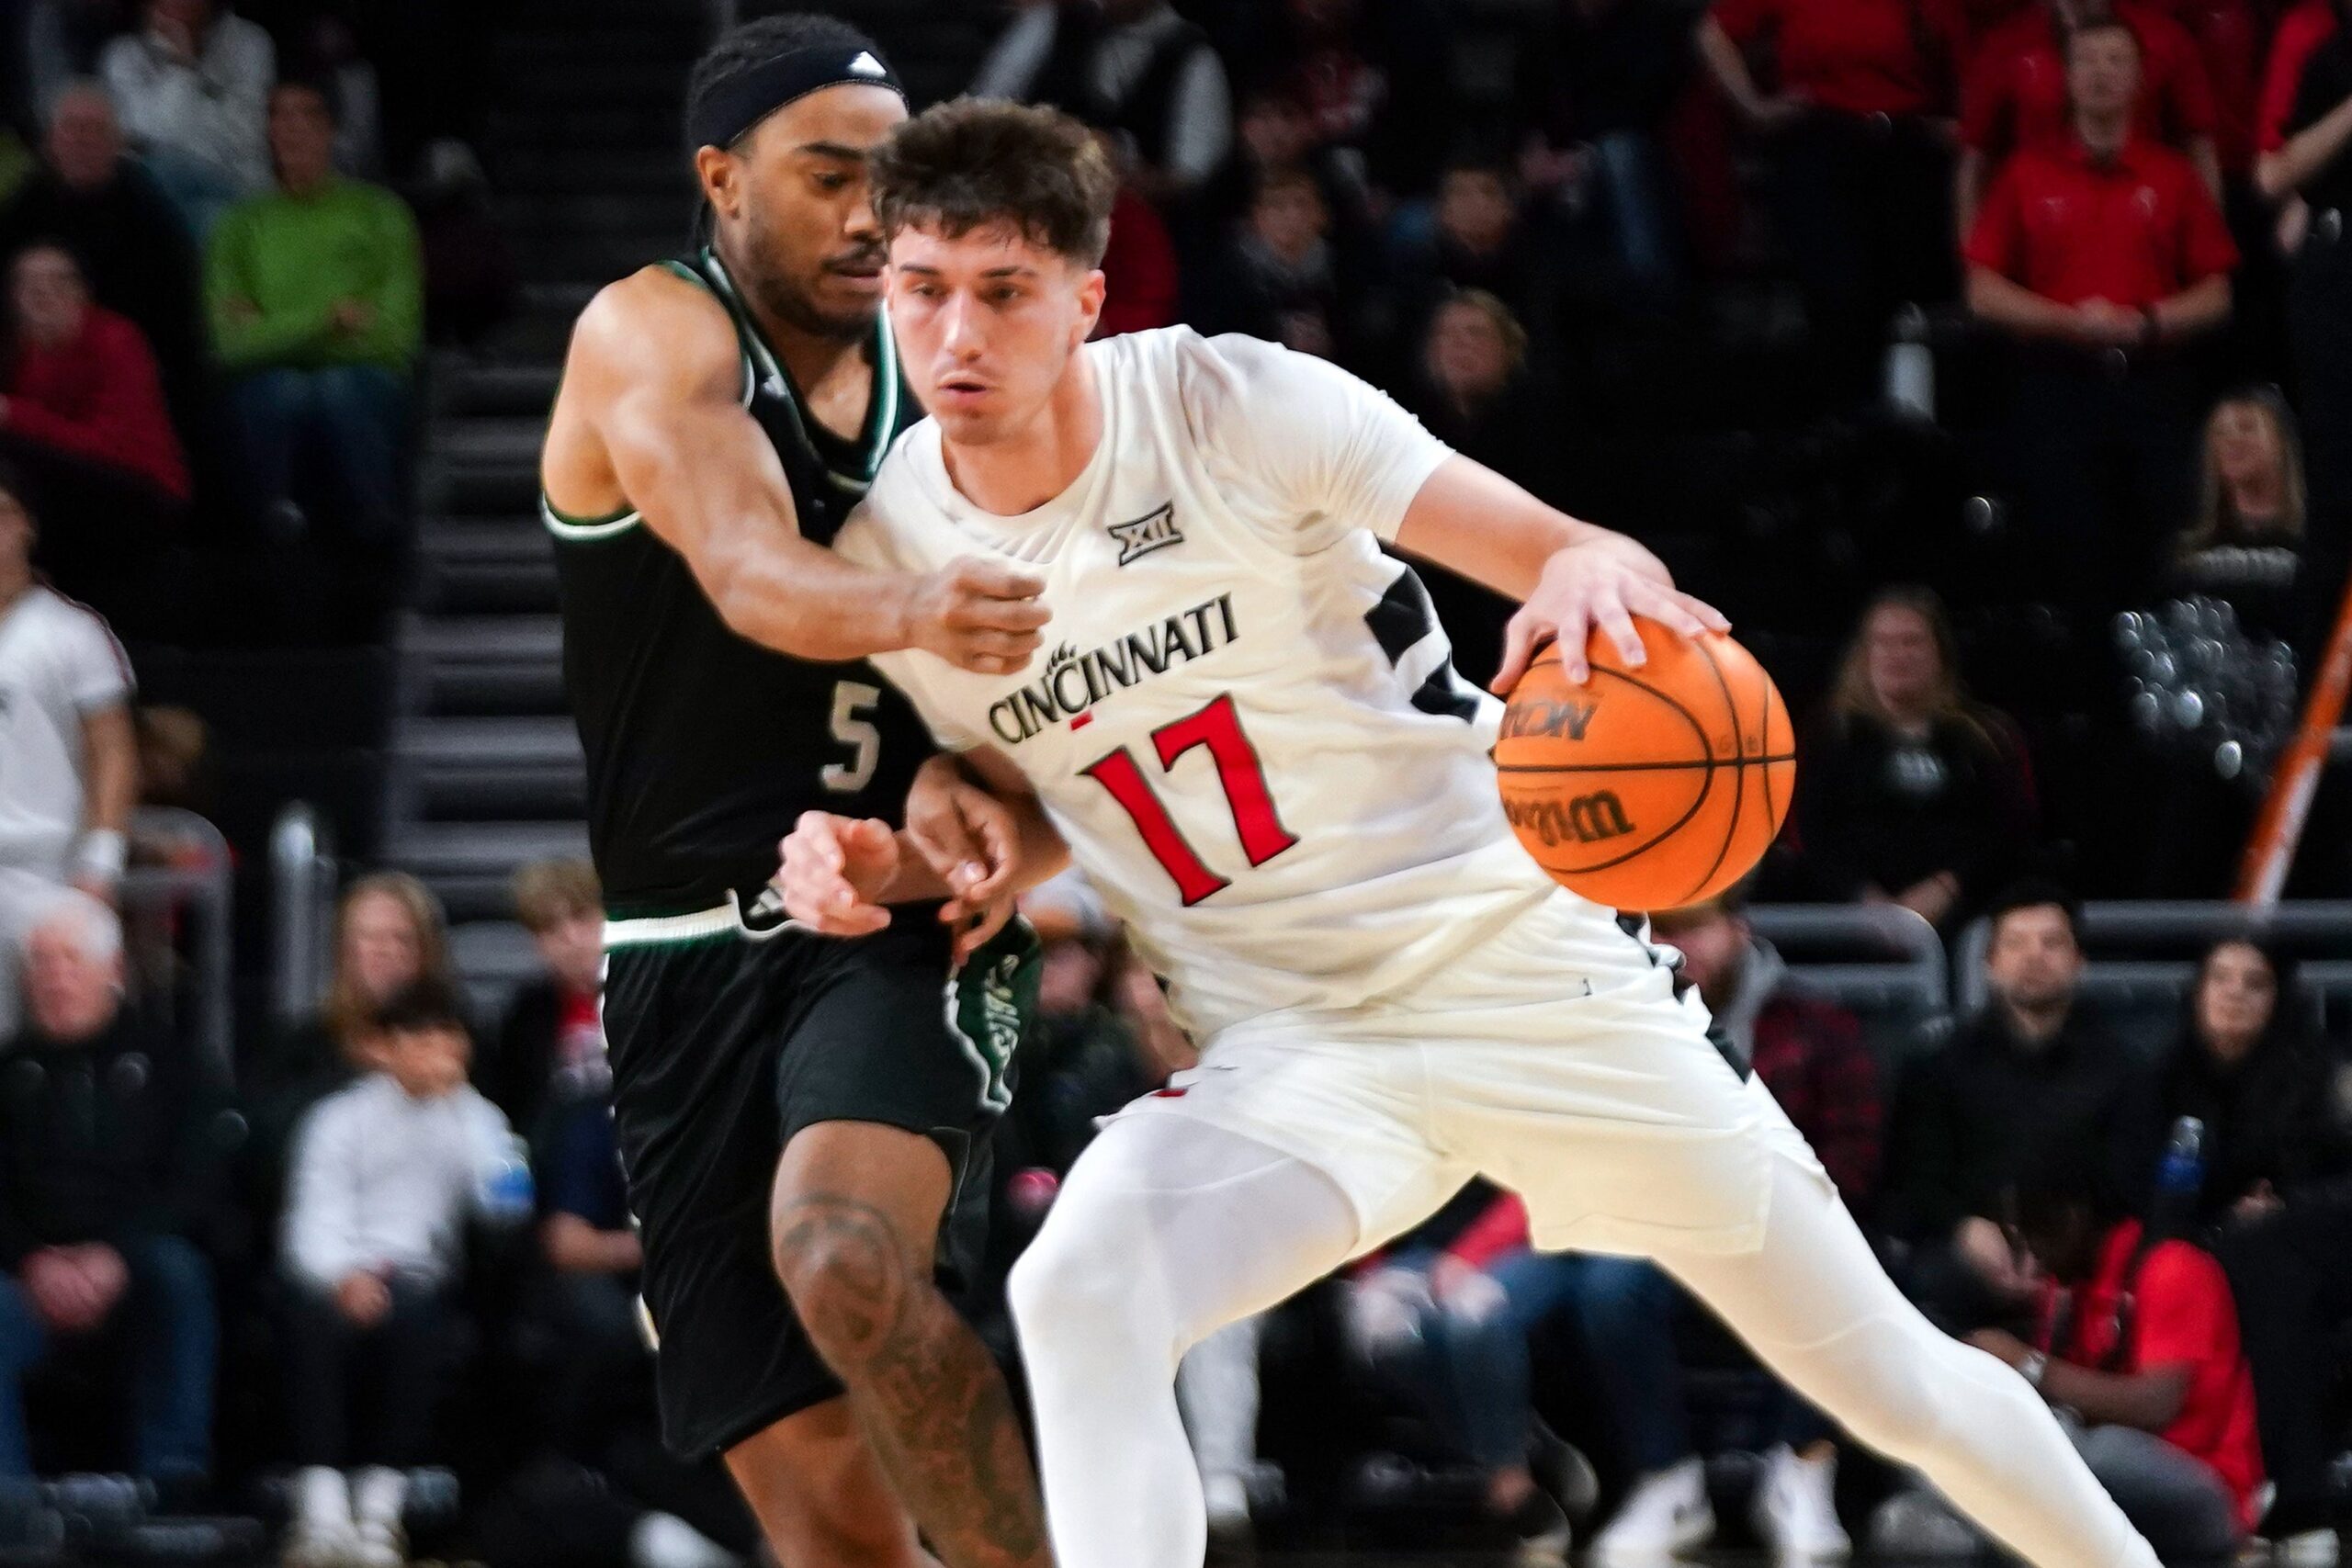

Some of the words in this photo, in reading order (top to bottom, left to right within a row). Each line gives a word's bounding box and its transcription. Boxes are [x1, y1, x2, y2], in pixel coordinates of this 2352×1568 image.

[820, 680, 881, 793] 5
[989, 592, 1240, 745] CINCINNATI
[1074, 691, 1301, 908] 17
